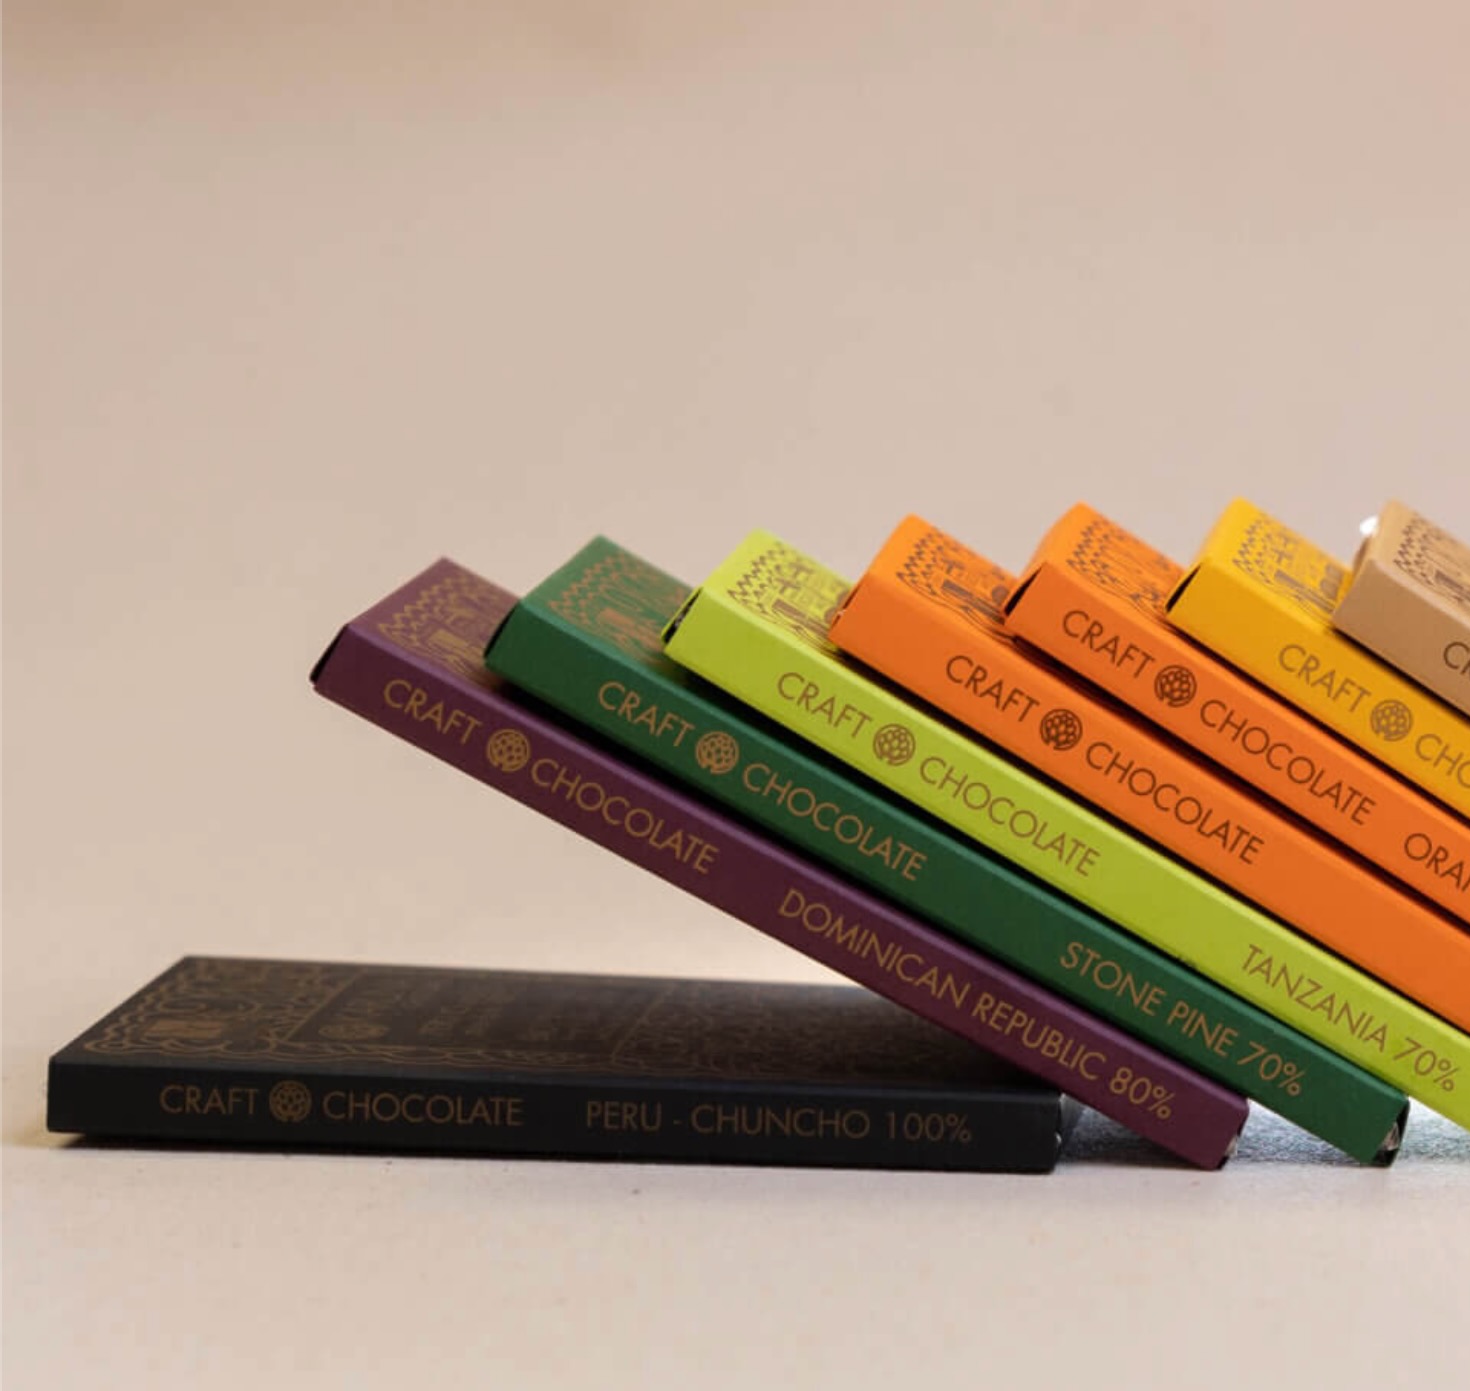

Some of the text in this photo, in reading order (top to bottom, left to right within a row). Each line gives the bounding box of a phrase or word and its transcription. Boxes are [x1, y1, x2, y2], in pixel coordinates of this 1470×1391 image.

[945, 655, 1041, 723] CRAFT
[1085, 742, 1265, 866] CHOCOLATE
[1062, 610, 1156, 679] CRAFT
[1199, 699, 1378, 825] CHOCOLATE
[1277, 645, 1371, 713] CRAFT
[383, 679, 1173, 1121] CRAFT CHOCOLATE DOMINICAN REPUBLIC 80%
[599, 681, 1309, 1096] CRAFT CHOCOLATE STONE PINE 70%
[776, 672, 1460, 1093] CRAFT CHOCOLATE TANZANIA 70%
[159, 1084, 260, 1117] CRAFT
[322, 1091, 524, 1127] CHOCOLATE
[585, 1102, 663, 1132] PERU
[691, 1105, 870, 1140] CHUNCHO
[886, 1108, 973, 1144] 100%
